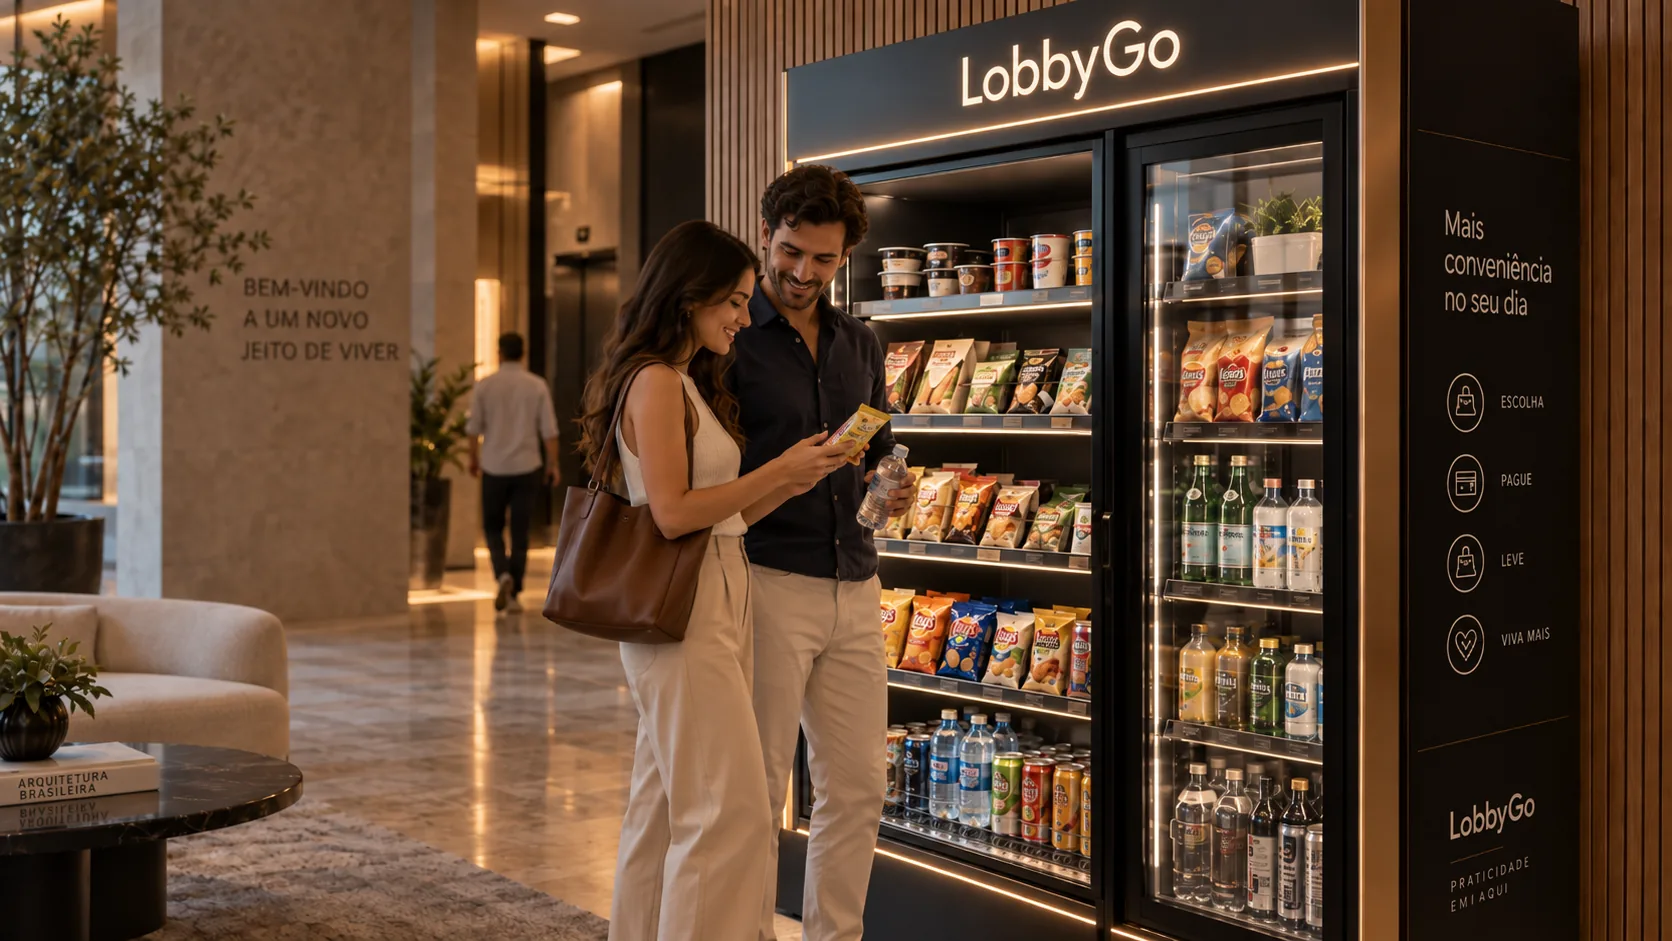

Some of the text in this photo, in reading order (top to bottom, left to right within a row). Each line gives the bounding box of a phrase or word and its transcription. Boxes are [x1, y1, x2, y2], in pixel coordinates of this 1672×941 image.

[962, 20, 1181, 107] LobbyGo
[1445, 209, 1484, 240] Mais
[1444, 253, 1552, 284] conveniência
[243, 278, 369, 299] BEM-VINDO
[1445, 289, 1528, 316] no seu dia
[243, 309, 369, 330] A UM NOVO
[240, 340, 399, 362] JEITO DE VIVER
[1501, 395, 1544, 409] ESCOLHA
[1501, 472, 1532, 487] PAGUE
[1501, 552, 1524, 568] LEVE
[1501, 626, 1551, 646] VIVA MAIS
[18, 771, 108, 789] ARQUITETURA
[20, 783, 96, 800] BRASILEIRA
[1450, 792, 1535, 840] LobbyGo
[1450, 856, 1529, 893] PRATICIDADE
[1478, 882, 1508, 902] AQUI
